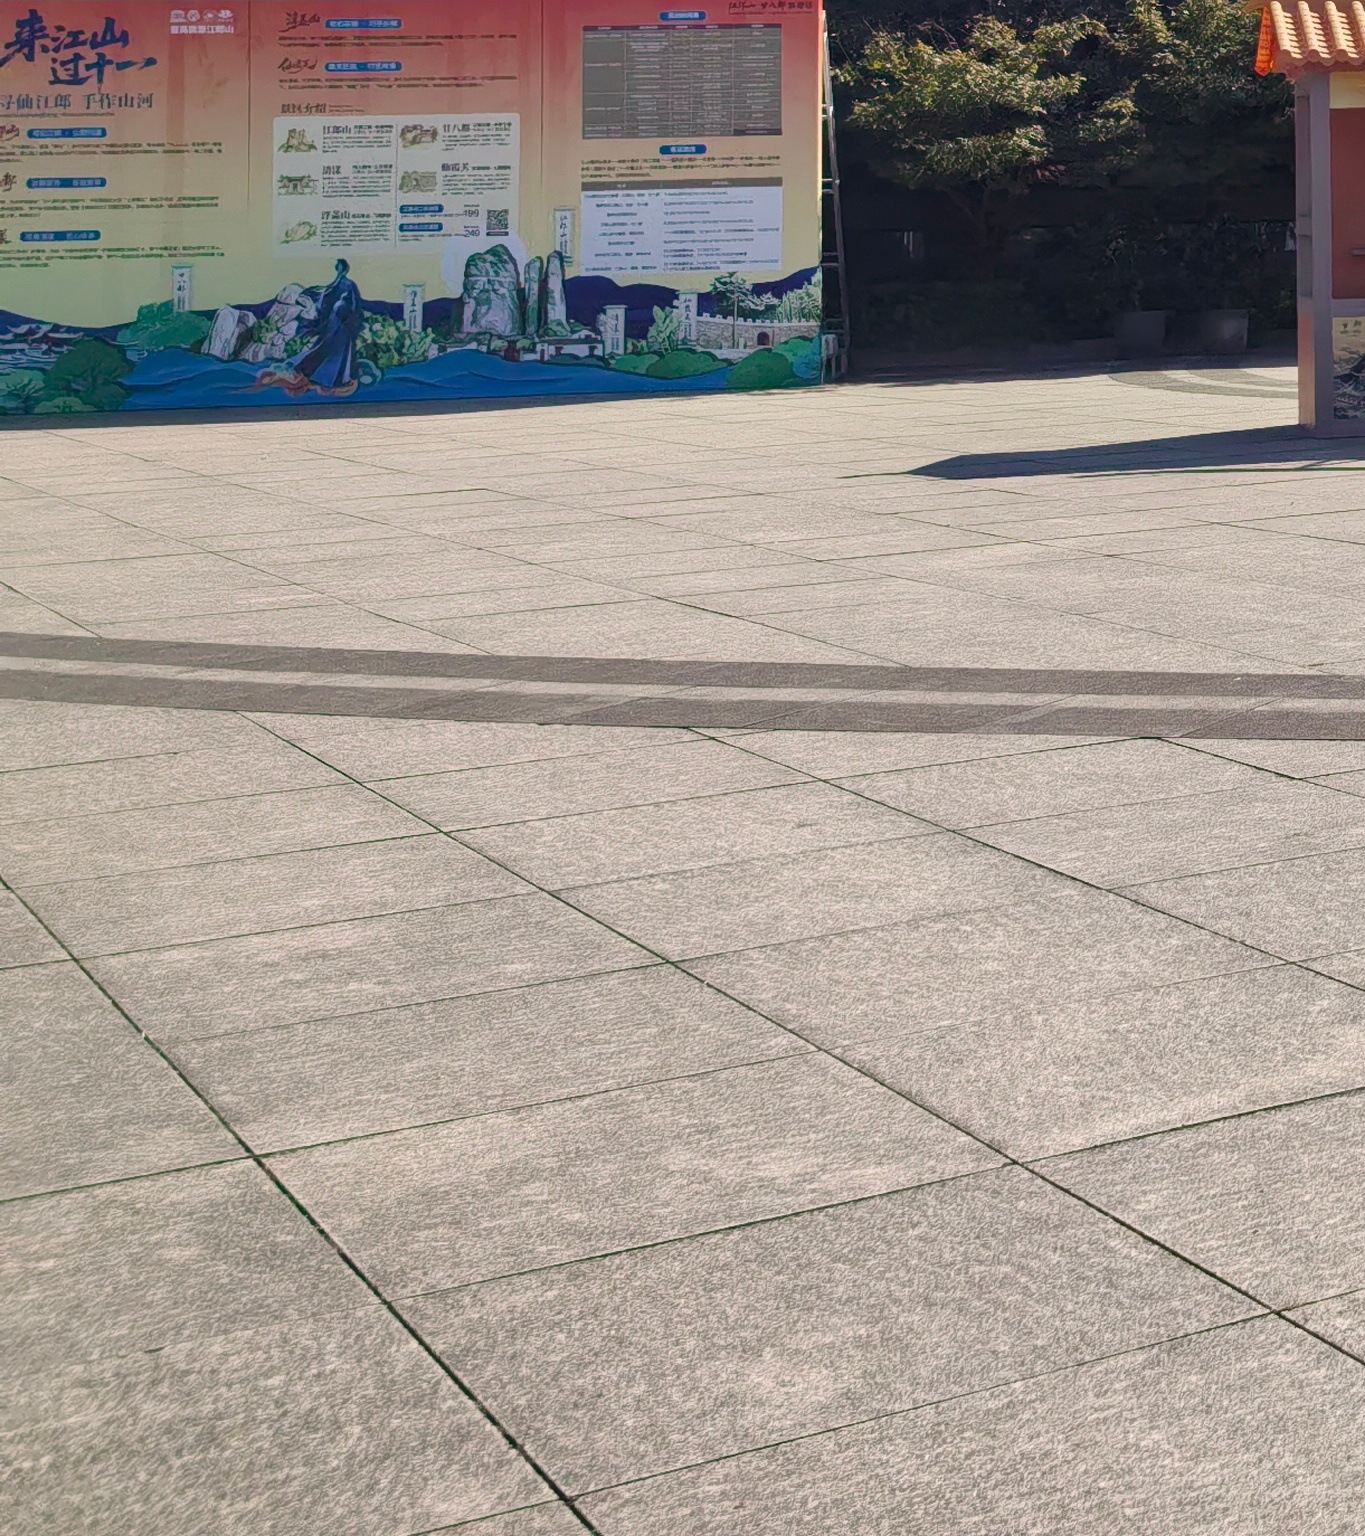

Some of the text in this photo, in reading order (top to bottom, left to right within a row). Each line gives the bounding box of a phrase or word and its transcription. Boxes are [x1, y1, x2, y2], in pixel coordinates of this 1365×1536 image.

[0, 9, 130, 65] 来江山
[48, 52, 158, 88] 过十一
